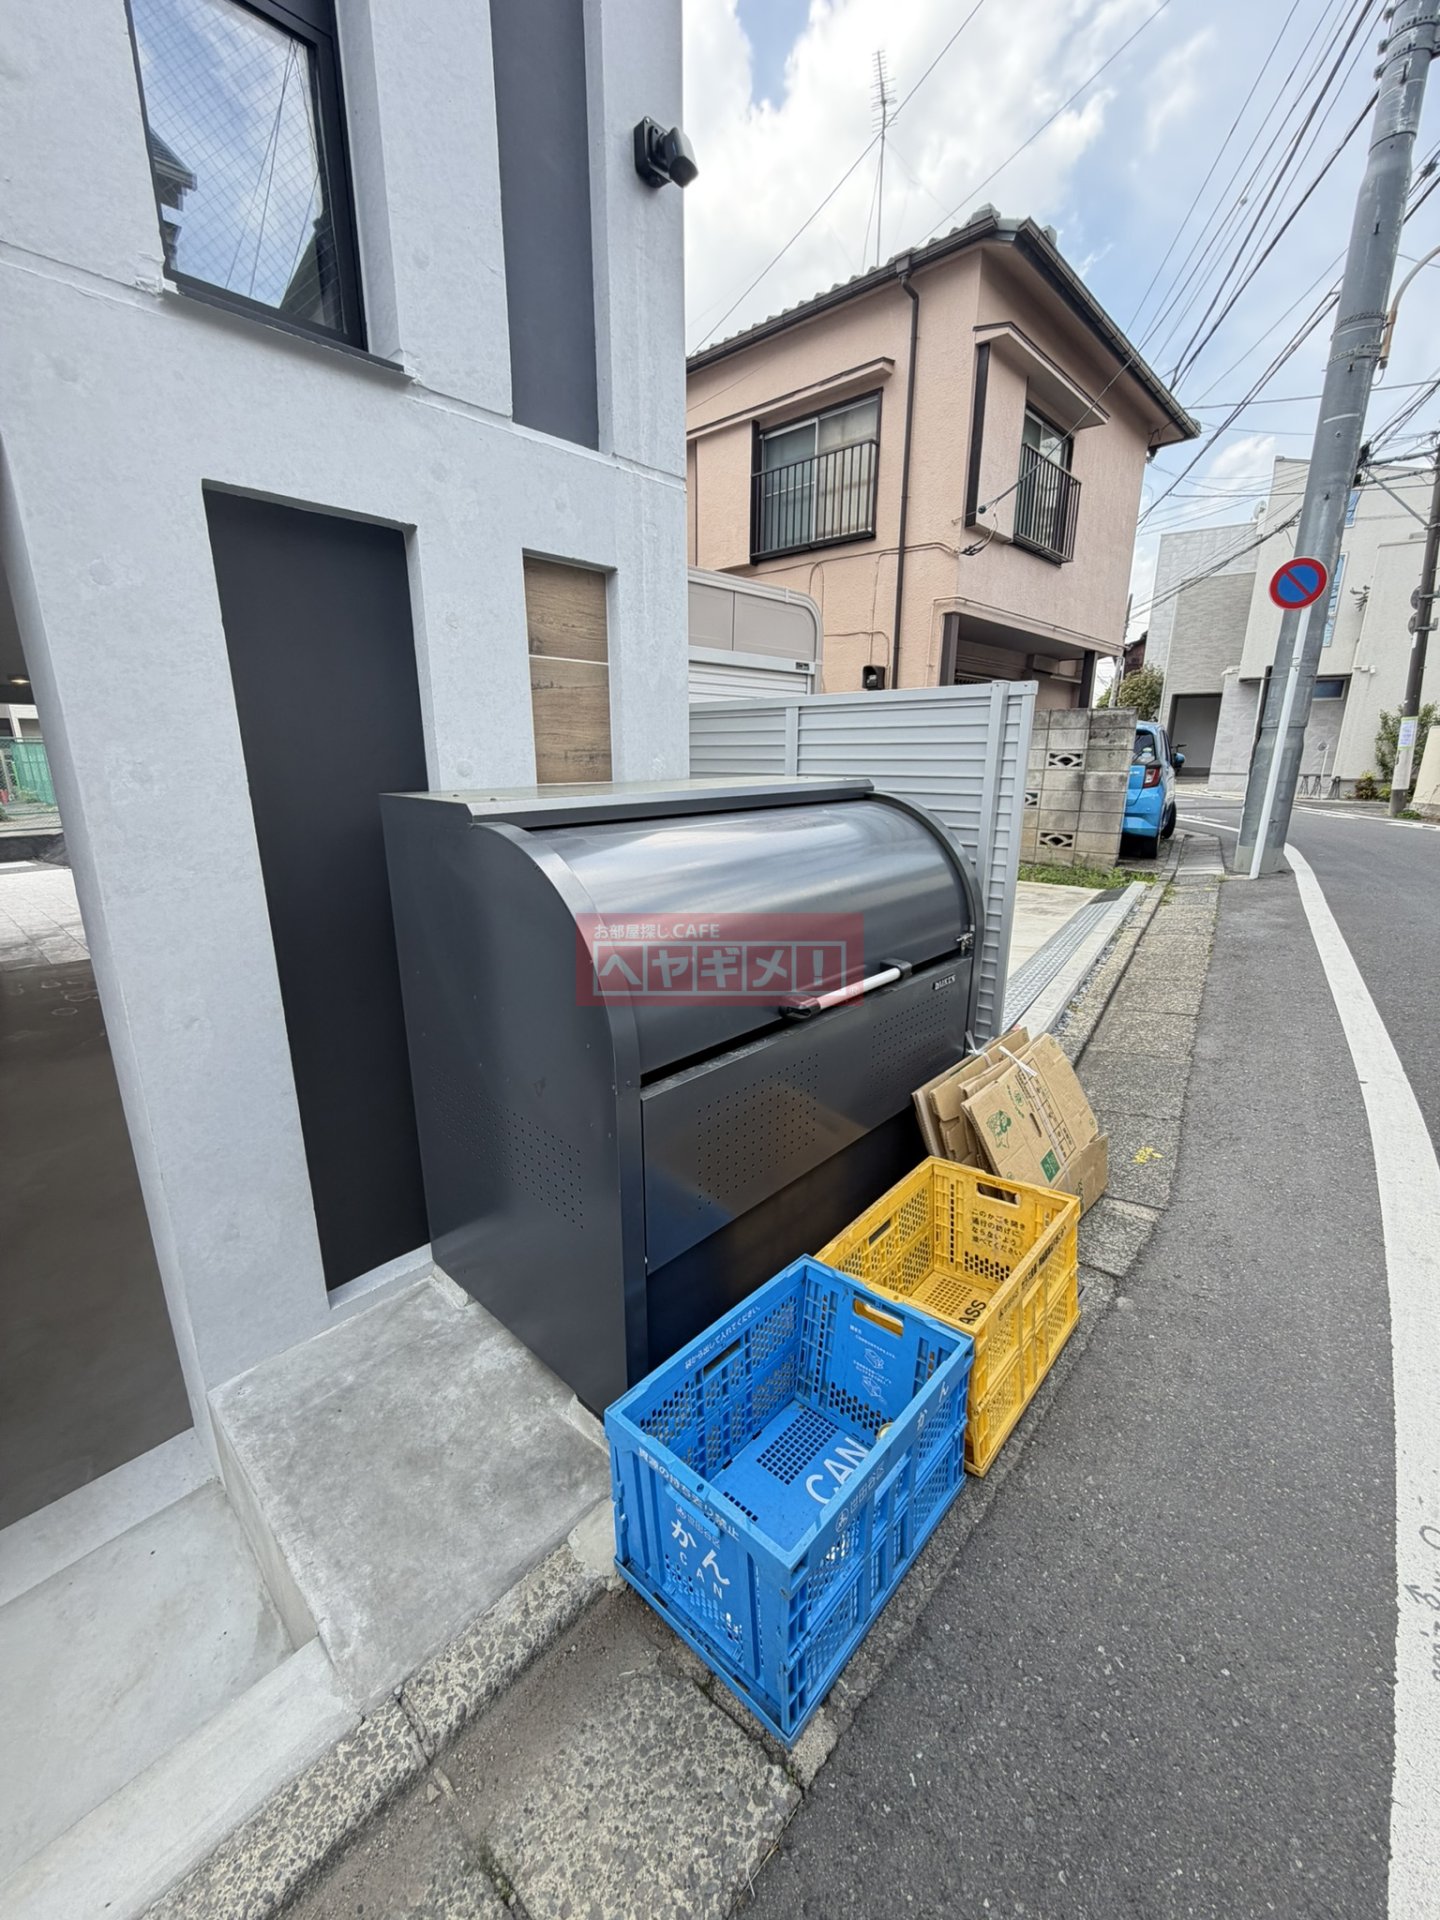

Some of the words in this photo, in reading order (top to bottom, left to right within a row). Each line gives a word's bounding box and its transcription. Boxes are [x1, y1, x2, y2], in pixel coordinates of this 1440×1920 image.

[958, 1299, 987, 1324] ASS
[806, 1437, 870, 1504] CAN
[669, 1518, 731, 1586] かん
